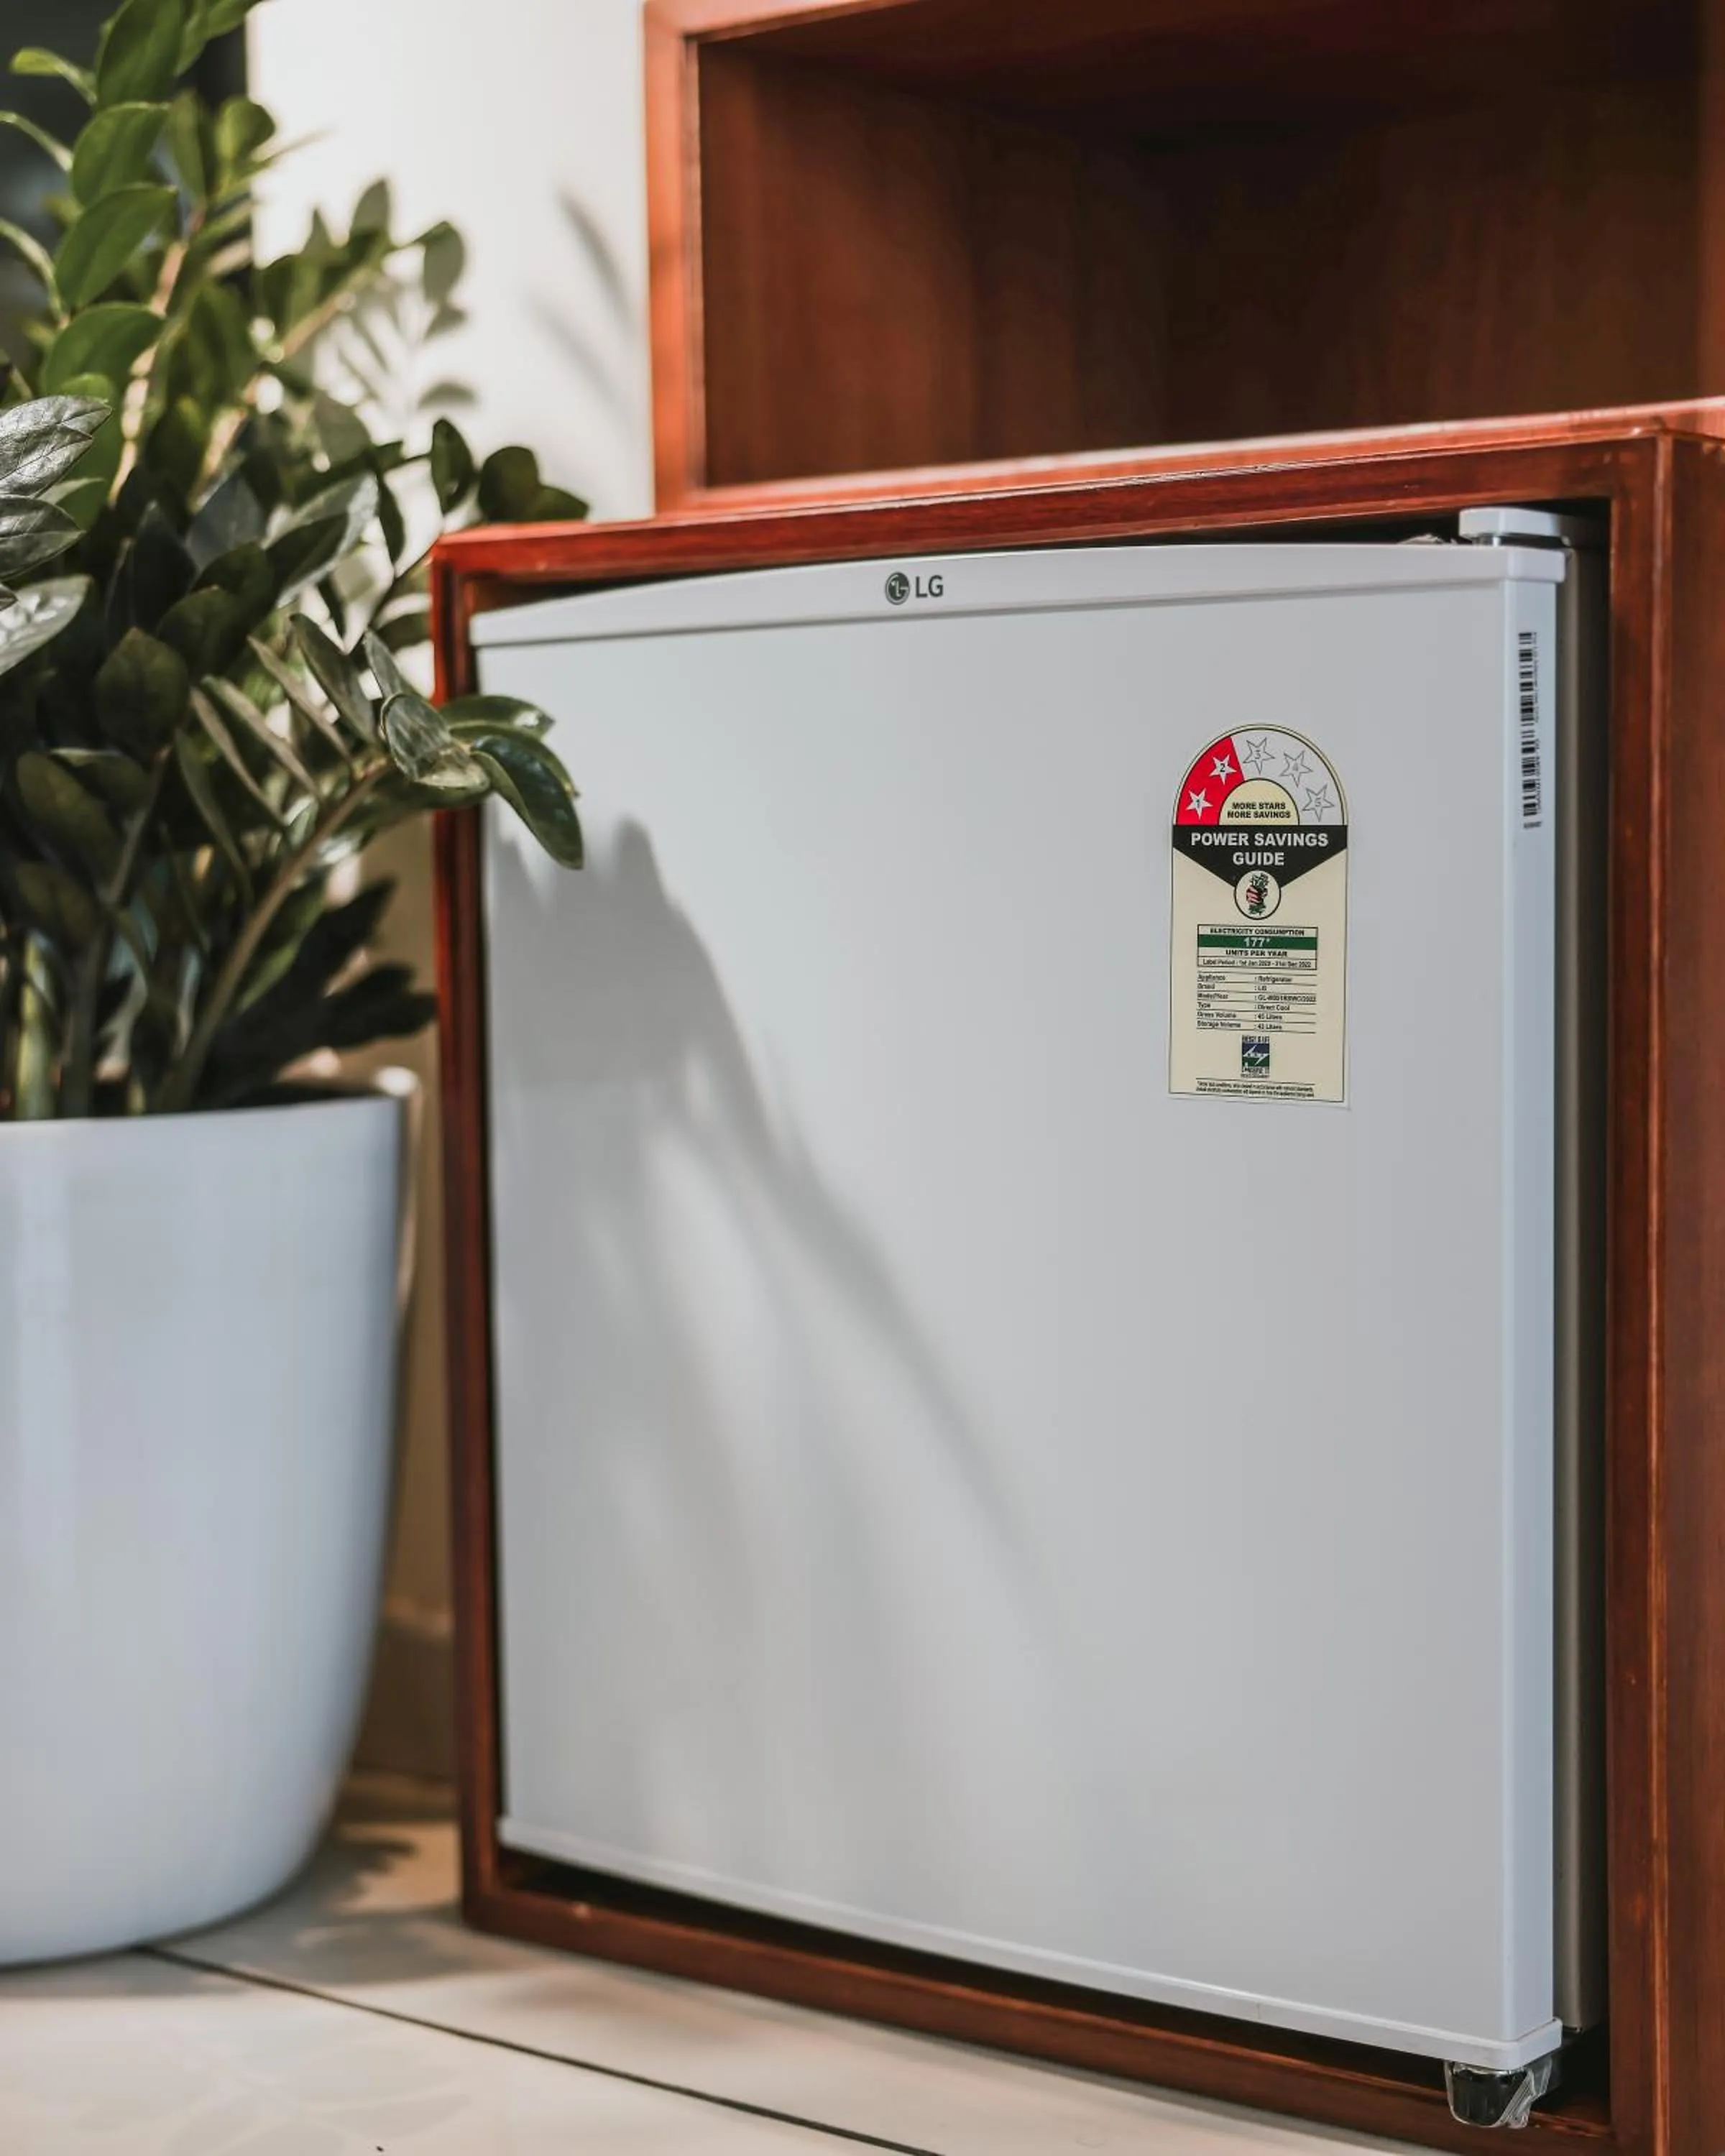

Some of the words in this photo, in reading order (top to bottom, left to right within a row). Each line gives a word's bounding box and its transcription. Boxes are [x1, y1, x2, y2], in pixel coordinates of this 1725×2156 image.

[916, 575, 944, 598] LG
[1220, 763, 1225, 773] 2
[1315, 798, 1321, 807] 5
[1191, 832, 1249, 847] POWER
[1254, 832, 1329, 847] SAVINGS
[1233, 852, 1285, 866] GUIDE
